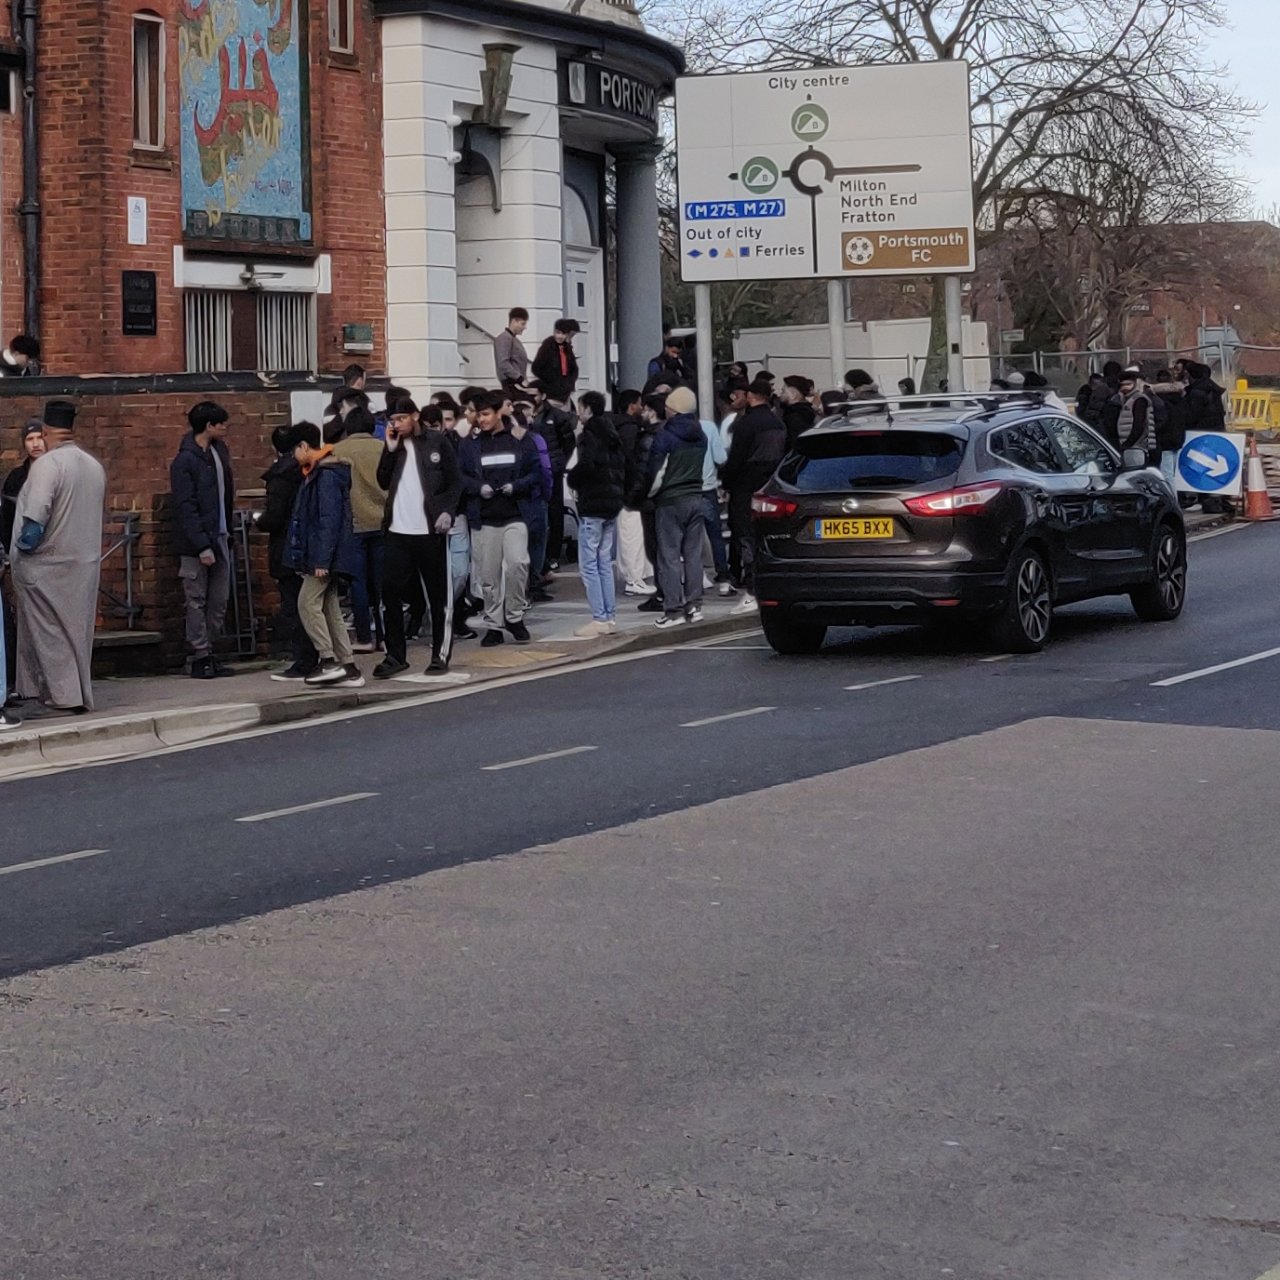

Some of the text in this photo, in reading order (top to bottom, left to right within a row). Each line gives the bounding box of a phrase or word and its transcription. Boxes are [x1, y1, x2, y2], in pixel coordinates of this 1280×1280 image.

[768, 74, 849, 90] City centre
[840, 180, 887, 192] Milton
[841, 193, 917, 208] North End
[841, 211, 896, 223] Fratton
[686, 226, 762, 240] Out of city
[879, 232, 964, 248] Portsmouth
[755, 244, 805, 257] Ferries
[911, 249, 932, 262] FC
[824, 521, 890, 535] HK65 BXX
